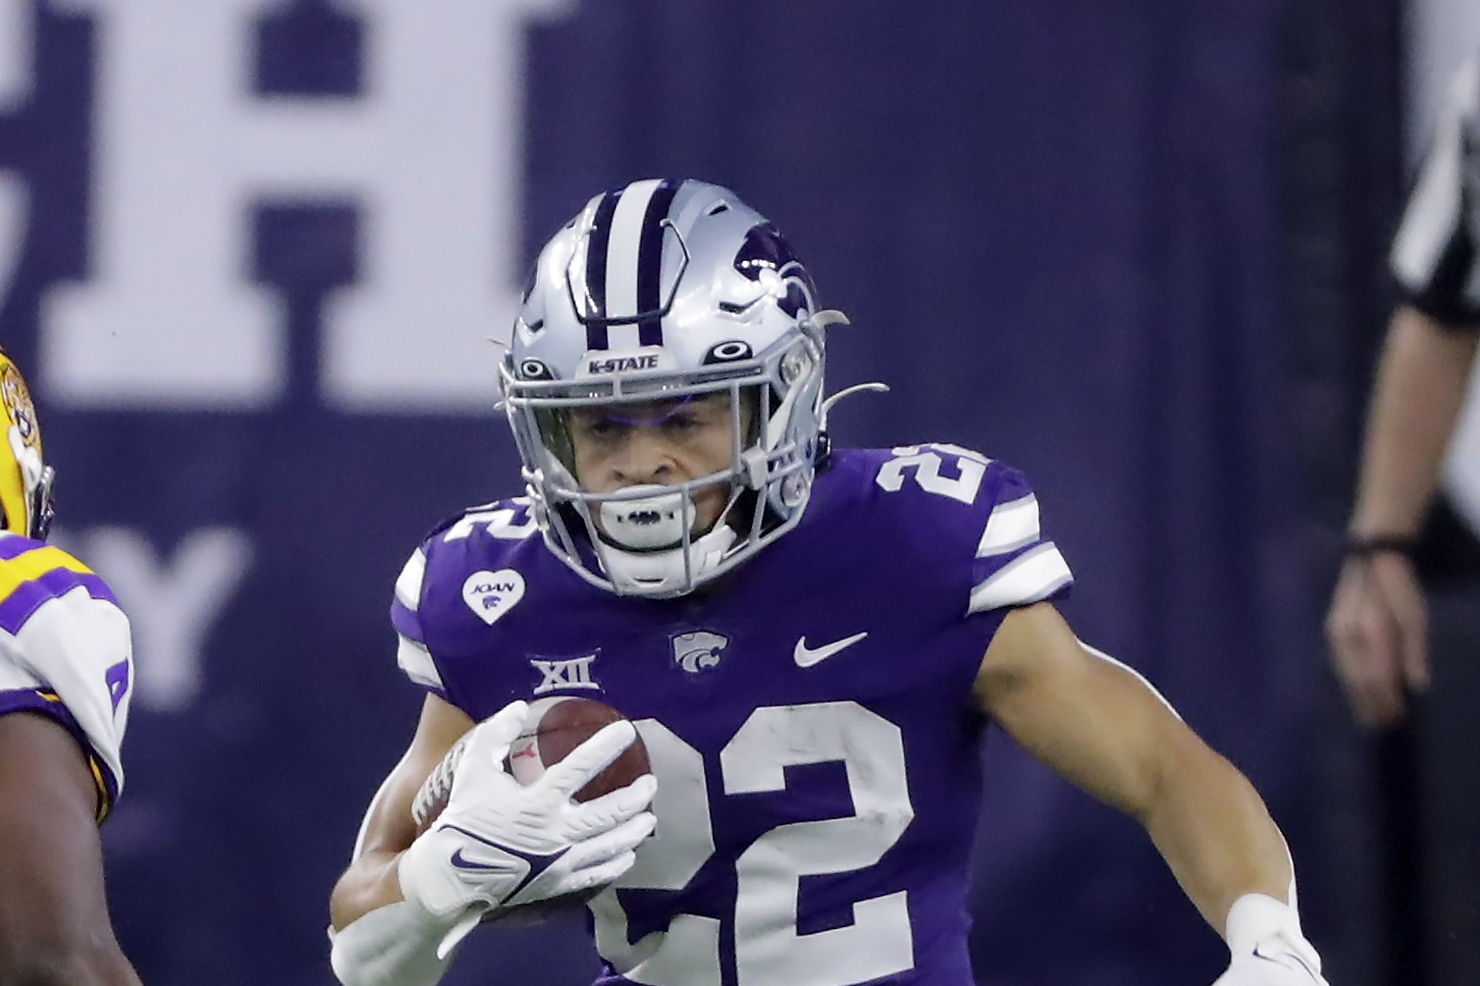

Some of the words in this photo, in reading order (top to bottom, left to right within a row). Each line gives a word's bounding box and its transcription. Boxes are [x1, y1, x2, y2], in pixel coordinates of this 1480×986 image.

[588, 355, 660, 374] K-STATE
[470, 582, 516, 595] JOAN
[529, 653, 602, 695] XII
